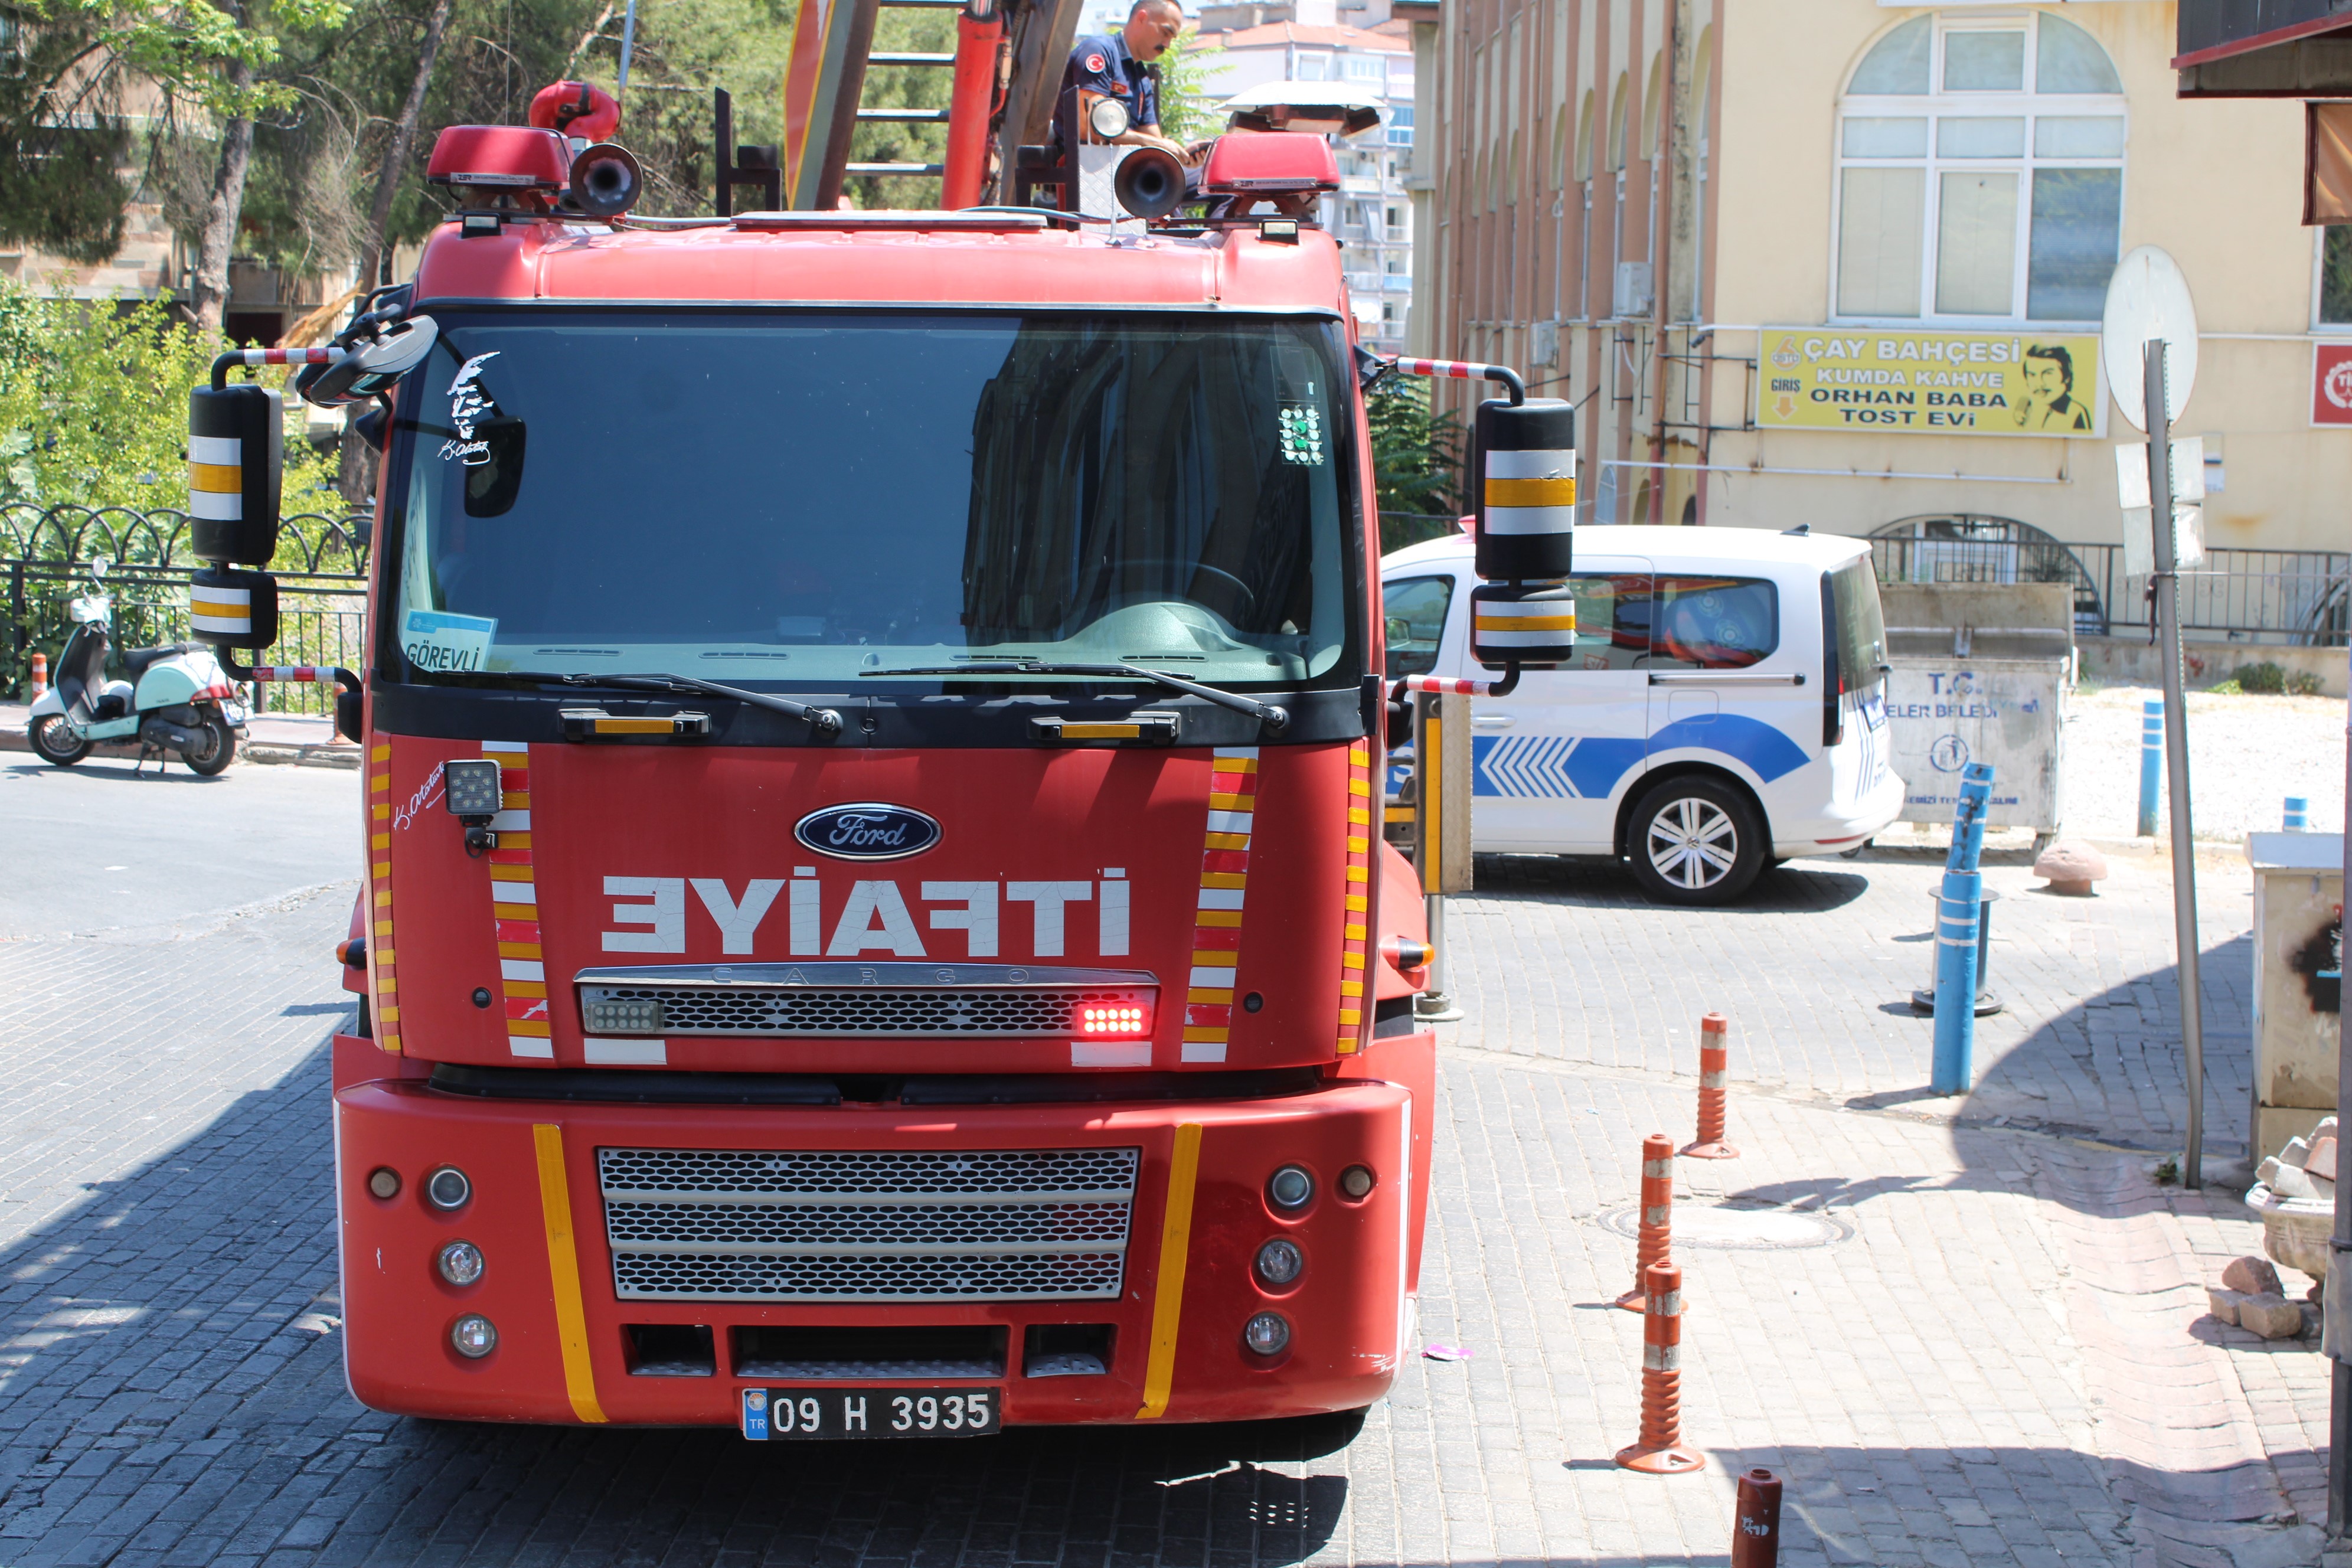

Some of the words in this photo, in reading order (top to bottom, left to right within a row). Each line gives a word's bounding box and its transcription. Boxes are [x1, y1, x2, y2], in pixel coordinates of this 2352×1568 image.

[1804, 338, 1868, 363] ÇAY
[1876, 338, 2020, 367] BAHÇESİ
[1771, 376, 1801, 393] GİRİŞ
[1817, 368, 1908, 386] KUMDA
[1915, 370, 2004, 388] KAHVE
[1811, 388, 1915, 405] ORHAN
[1927, 392, 2008, 407] BABA
[1840, 409, 1917, 424] TOST
[406, 639, 479, 671] GÖREVLİ
[1886, 704, 1930, 718] ELER
[829, 814, 907, 845] Ford
[711, 967, 1029, 985] CARGO
[773, 1397, 820, 1433] 09
[844, 1396, 867, 1431] H
[891, 1394, 990, 1431] 3935
[749, 1419, 766, 1429] TR
